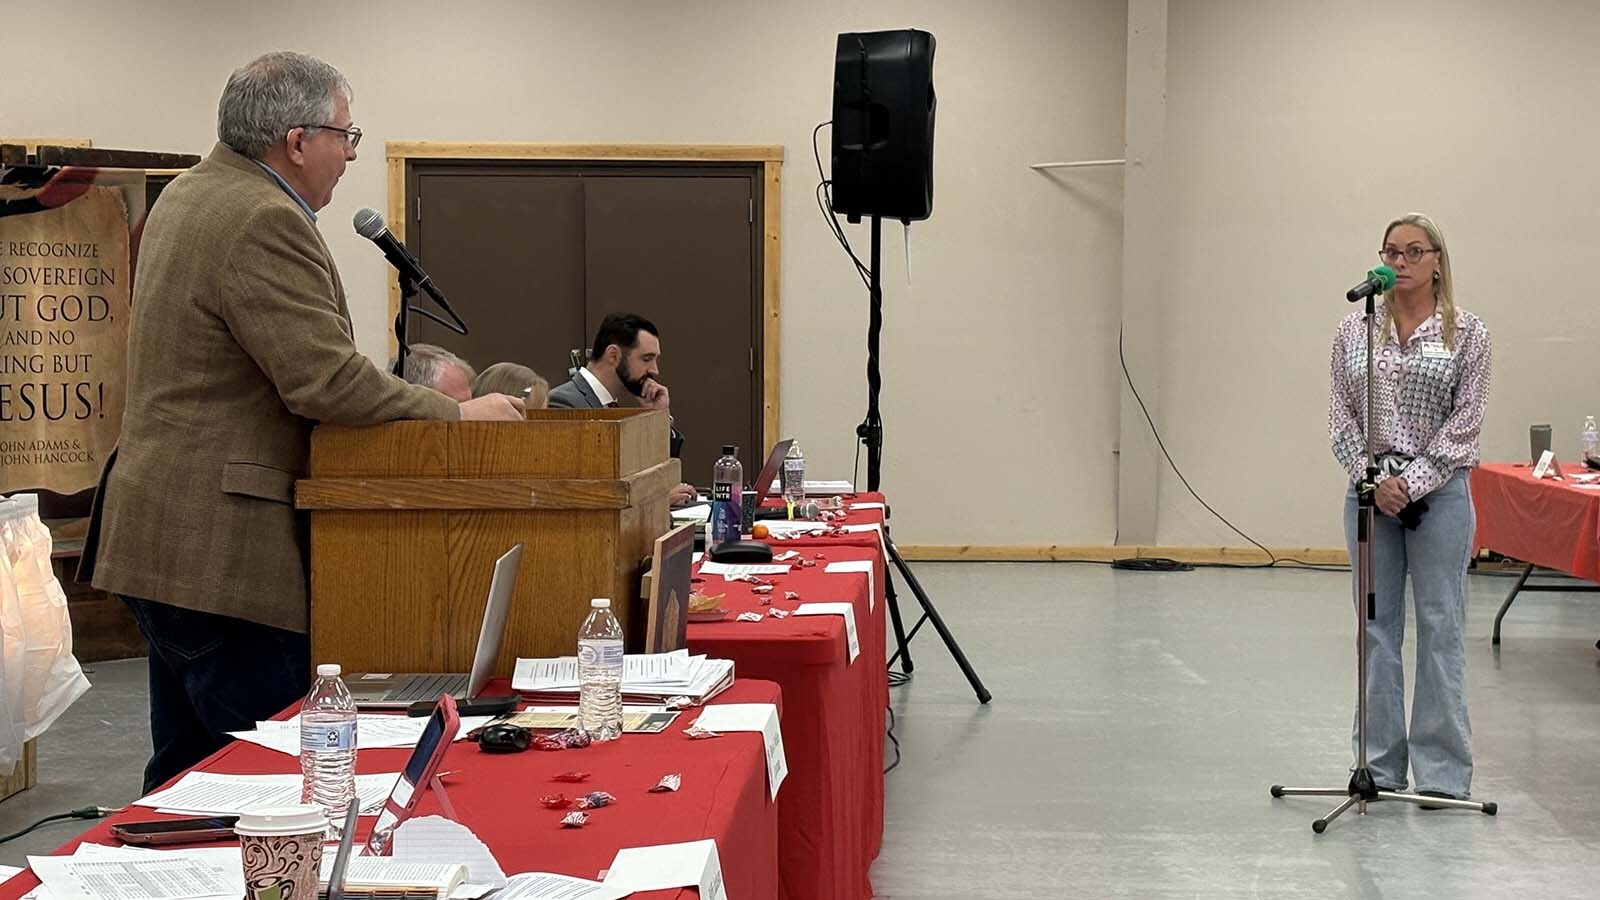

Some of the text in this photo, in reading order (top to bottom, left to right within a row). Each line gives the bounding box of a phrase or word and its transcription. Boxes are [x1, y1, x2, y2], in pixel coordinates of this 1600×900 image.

[8, 241, 100, 258] RECOGNIZE
[2, 266, 116, 286] SOVEREIGN
[36, 294, 114, 323] GOD,
[5, 329, 75, 346] AND NO
[0, 354, 92, 374] ING BUT
[0, 382, 104, 421] ESUS!
[0, 440, 80, 453] OHN ADAMS &
[0, 451, 94, 467] JOHN HANCOCK
